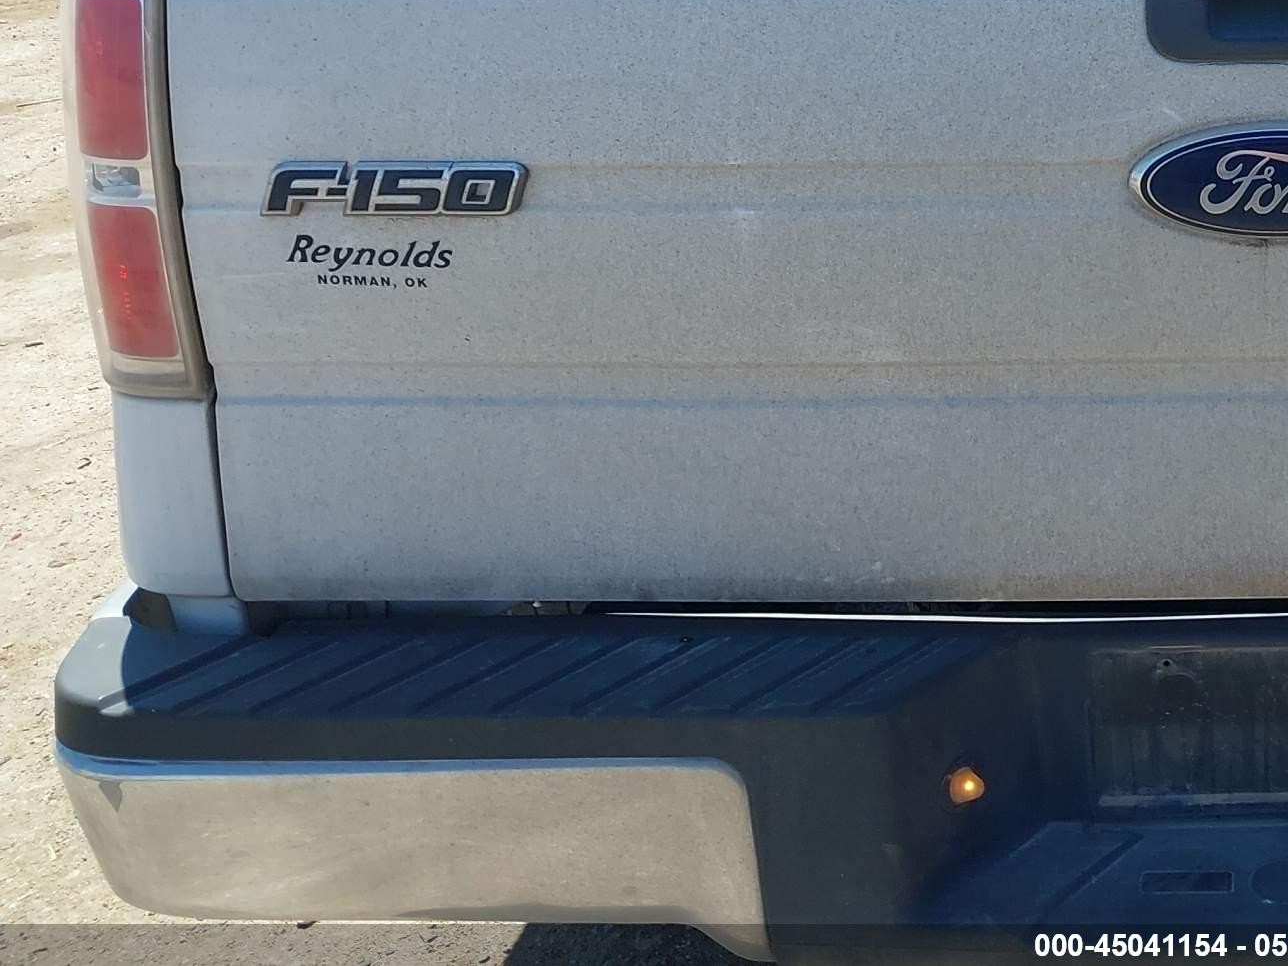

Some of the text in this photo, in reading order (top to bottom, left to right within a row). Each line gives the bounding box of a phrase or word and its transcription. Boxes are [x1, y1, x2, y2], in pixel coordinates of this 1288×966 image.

[260, 160, 530, 216] F-150
[286, 234, 453, 271] Reynolds
[317, 274, 429, 289] NORMAN, OK
